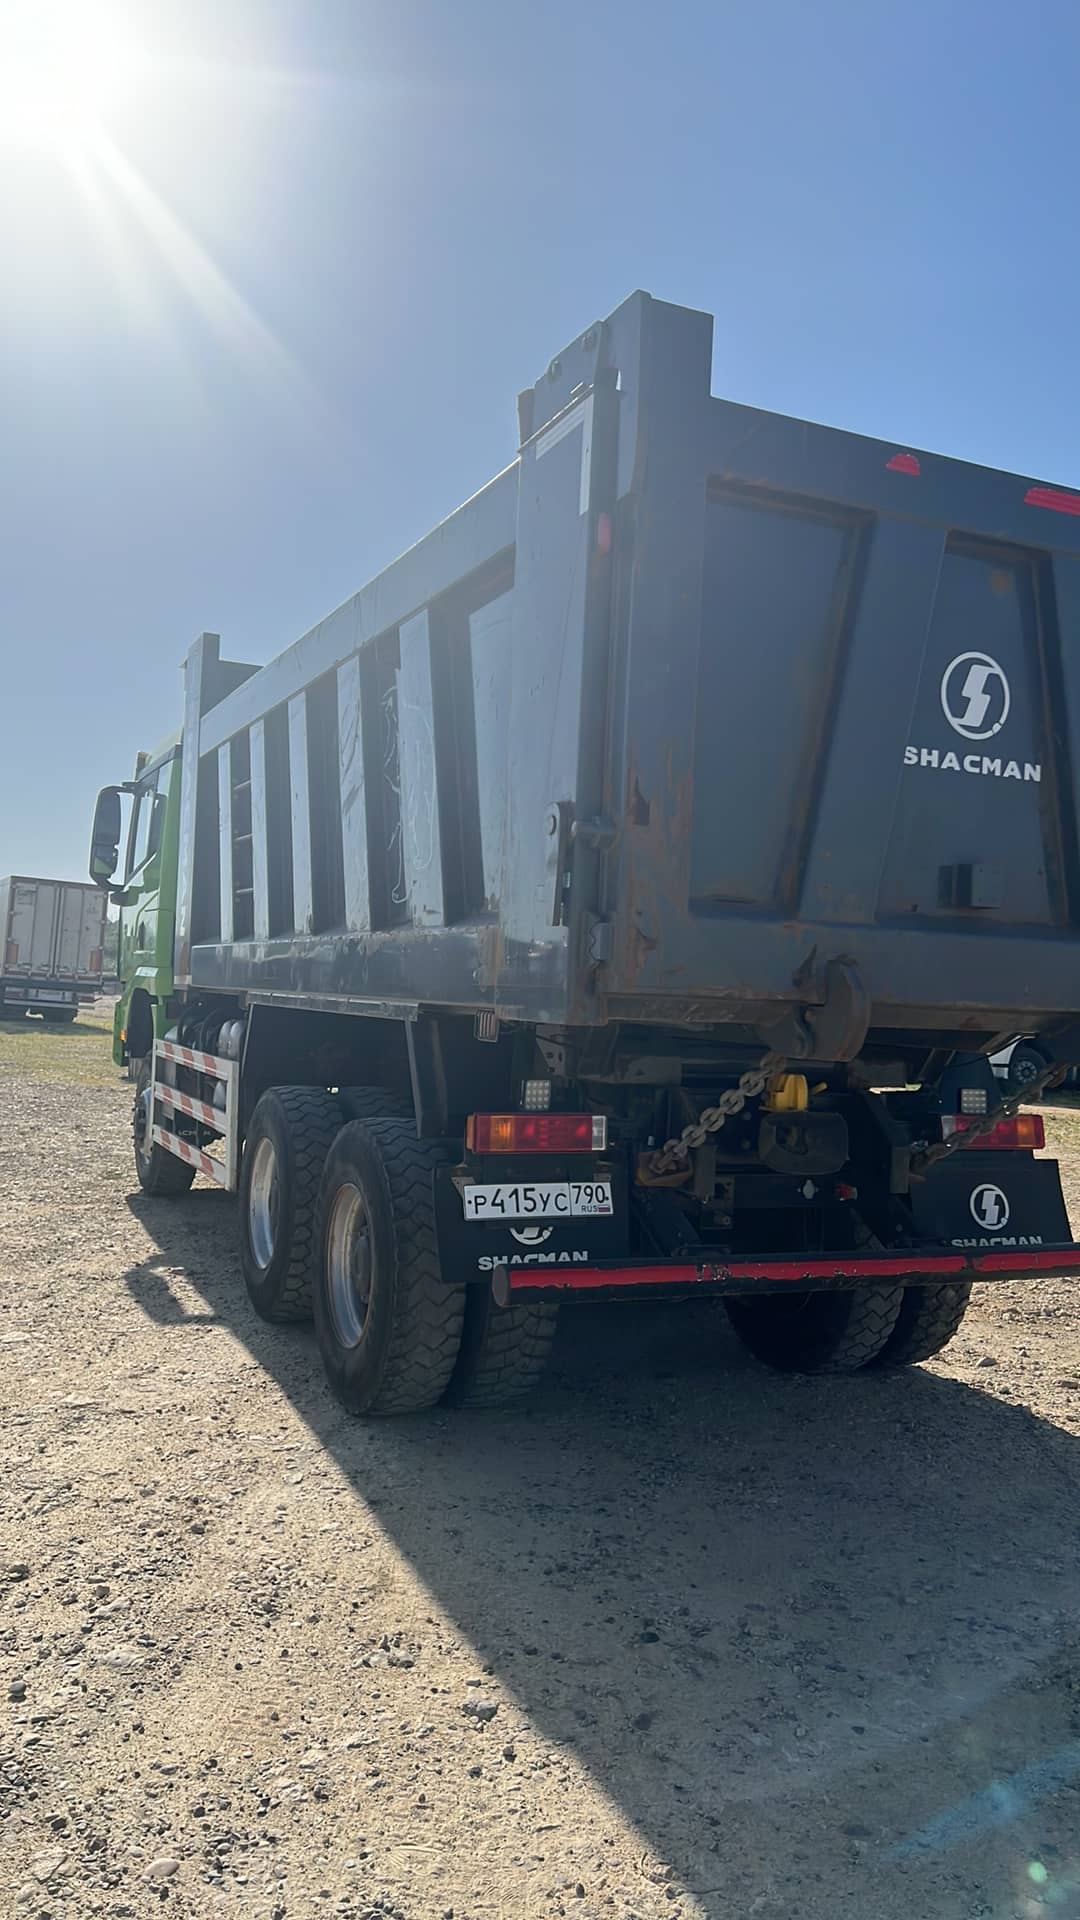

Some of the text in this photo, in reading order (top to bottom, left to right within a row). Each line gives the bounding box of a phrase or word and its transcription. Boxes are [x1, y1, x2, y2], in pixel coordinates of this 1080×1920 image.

[903, 746, 1042, 782] SHACMAN
[571, 1184, 606, 1205] 790
[581, 1204, 598, 1213] RUS
